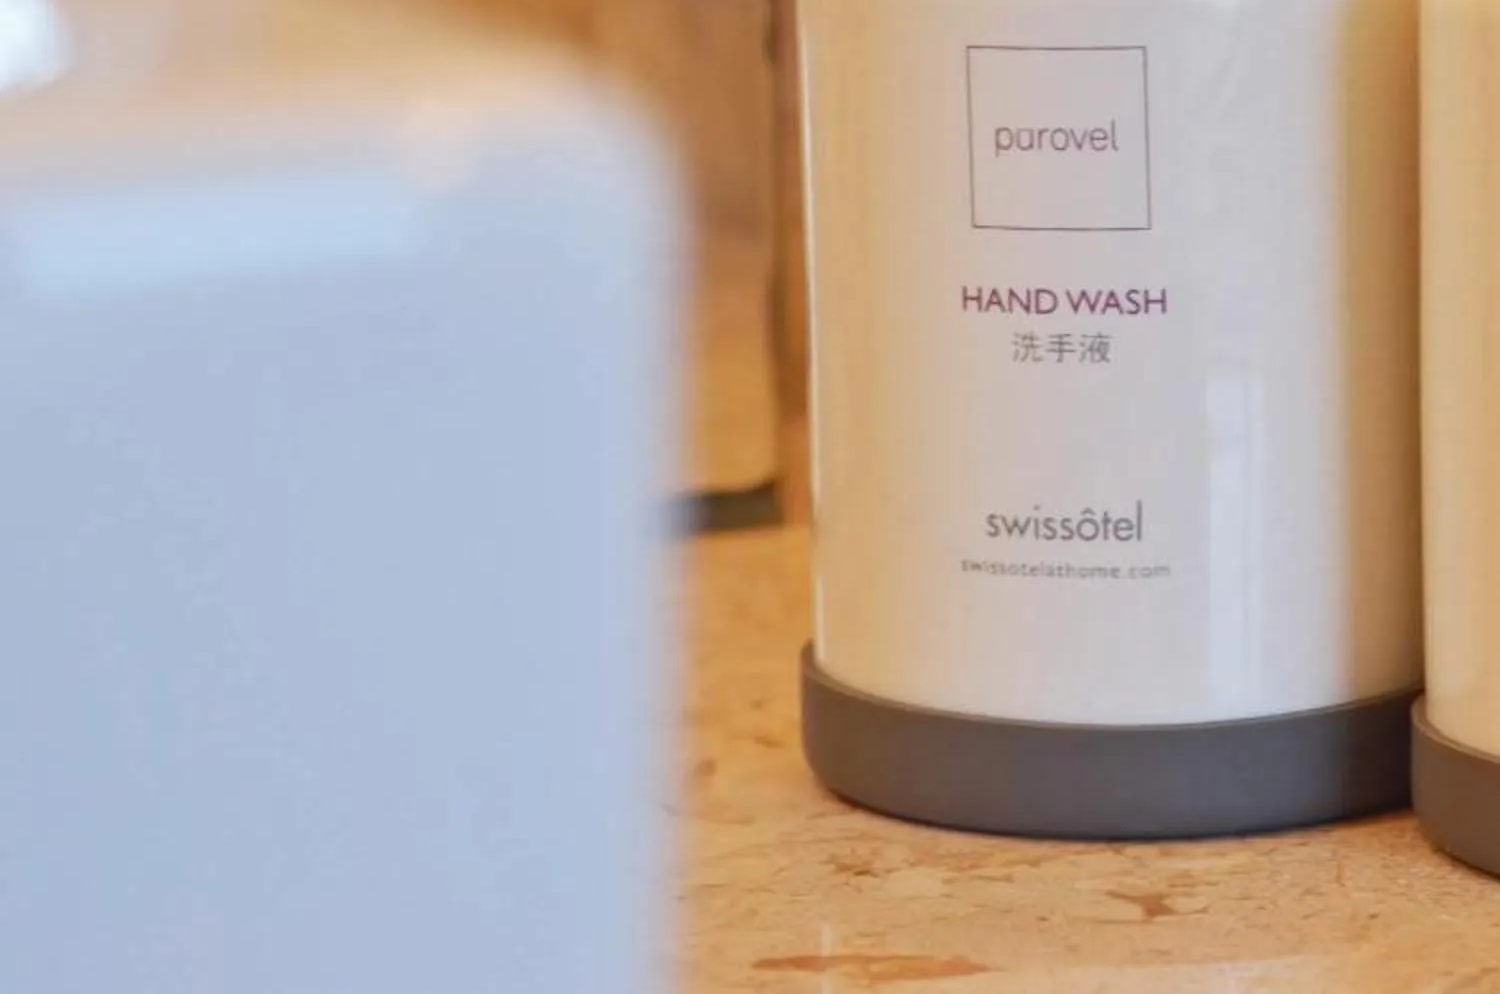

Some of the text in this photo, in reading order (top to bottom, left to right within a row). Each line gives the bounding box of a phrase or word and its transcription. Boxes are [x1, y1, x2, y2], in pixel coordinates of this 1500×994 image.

[961, 285, 1168, 315] HAND WASH
[1011, 330, 1114, 364] 洗手液
[984, 499, 1144, 542] swissôtel
